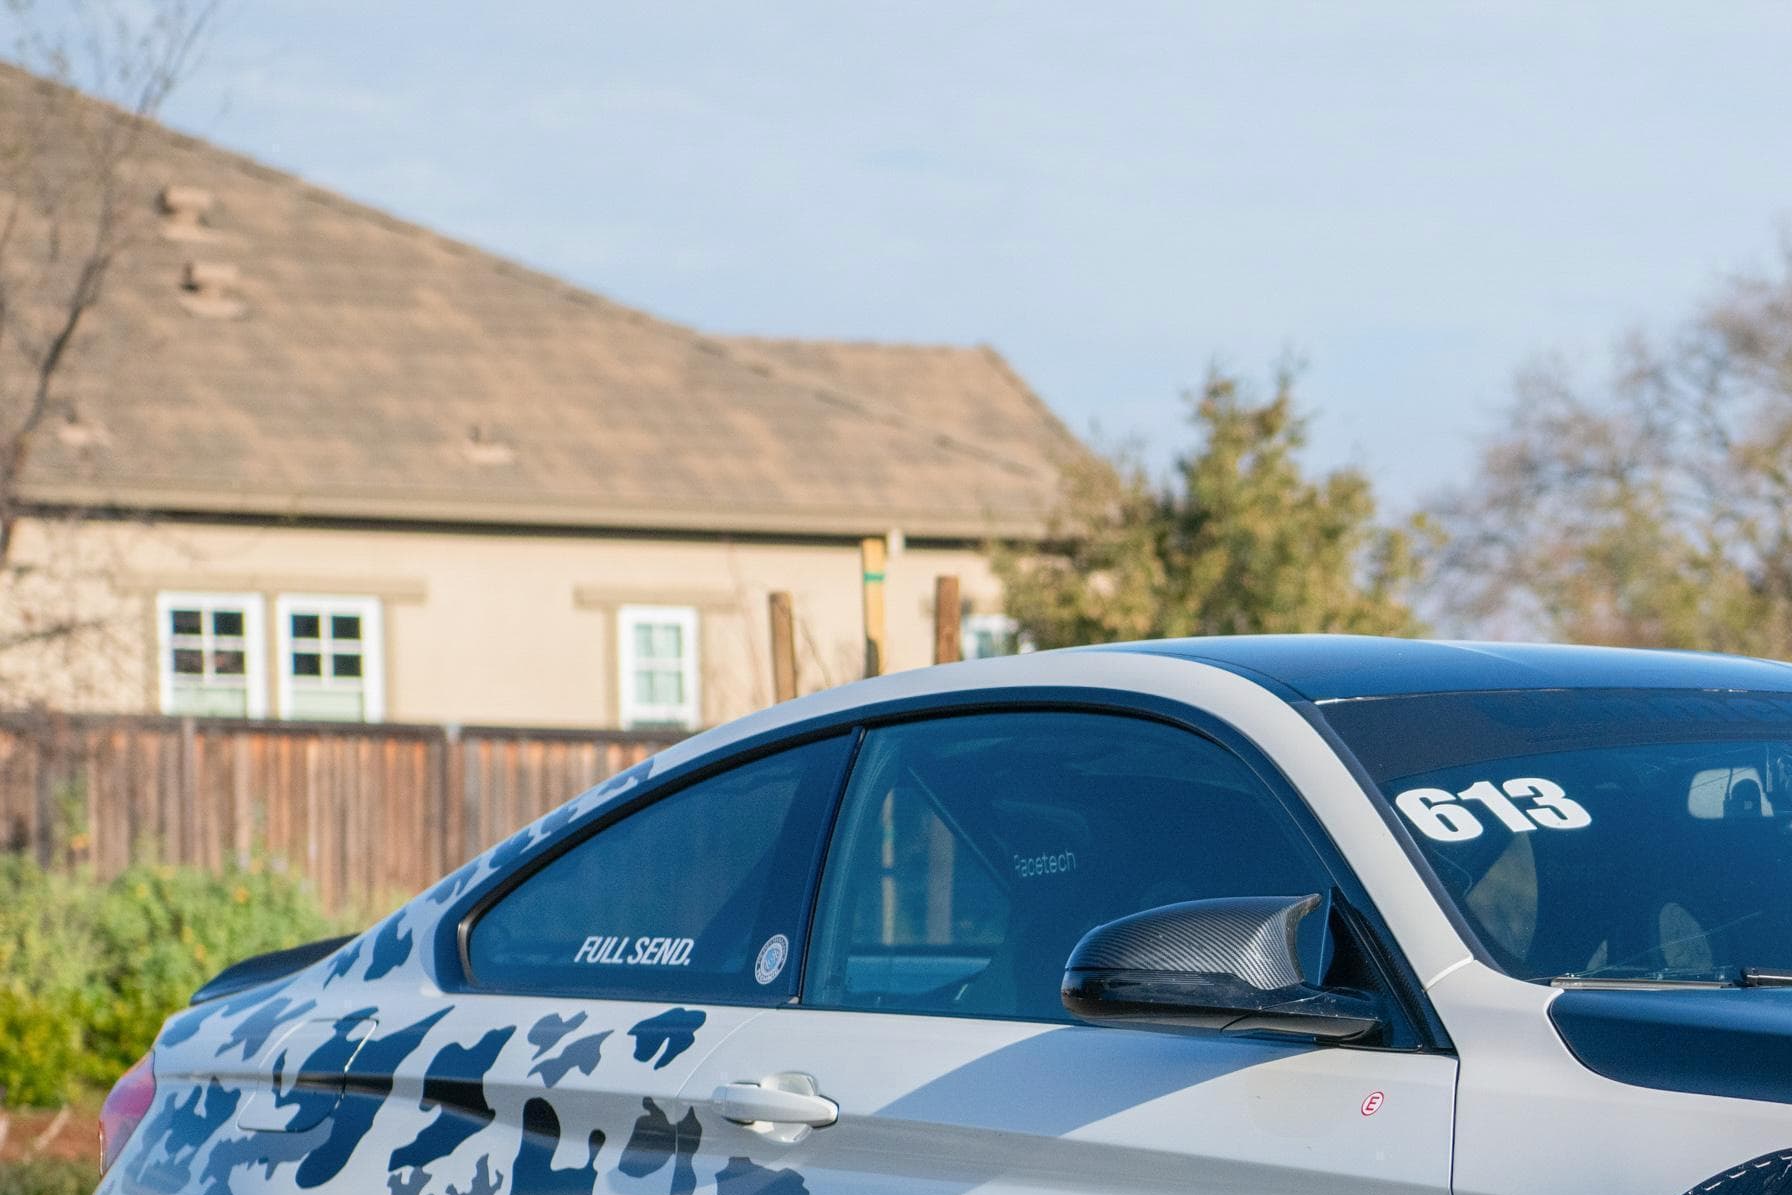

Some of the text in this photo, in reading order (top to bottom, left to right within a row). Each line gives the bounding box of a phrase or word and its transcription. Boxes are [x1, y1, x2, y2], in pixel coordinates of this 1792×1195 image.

[1395, 777, 1592, 842] 613
[574, 936, 695, 966] FULL SEND.
